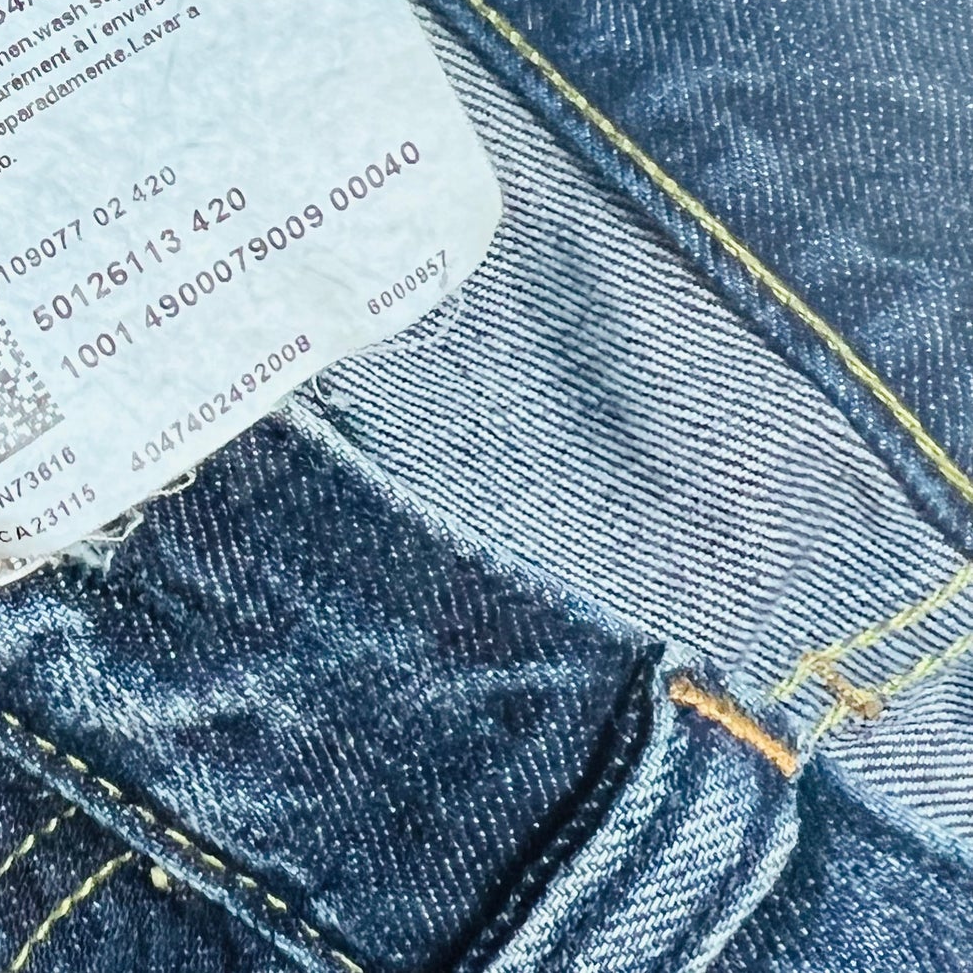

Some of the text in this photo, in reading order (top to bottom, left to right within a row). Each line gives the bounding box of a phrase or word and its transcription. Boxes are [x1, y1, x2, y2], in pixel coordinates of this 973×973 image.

[73, 34, 89, 54] à
[92, 196, 127, 226] 02
[132, 165, 177, 202] 420
[32, 186, 247, 331] 50126113 420
[61, 140, 421, 379] 1001 4900079009 00040
[367, 249, 448, 316] 6000957
[130, 334, 311, 473] 4047402492008
